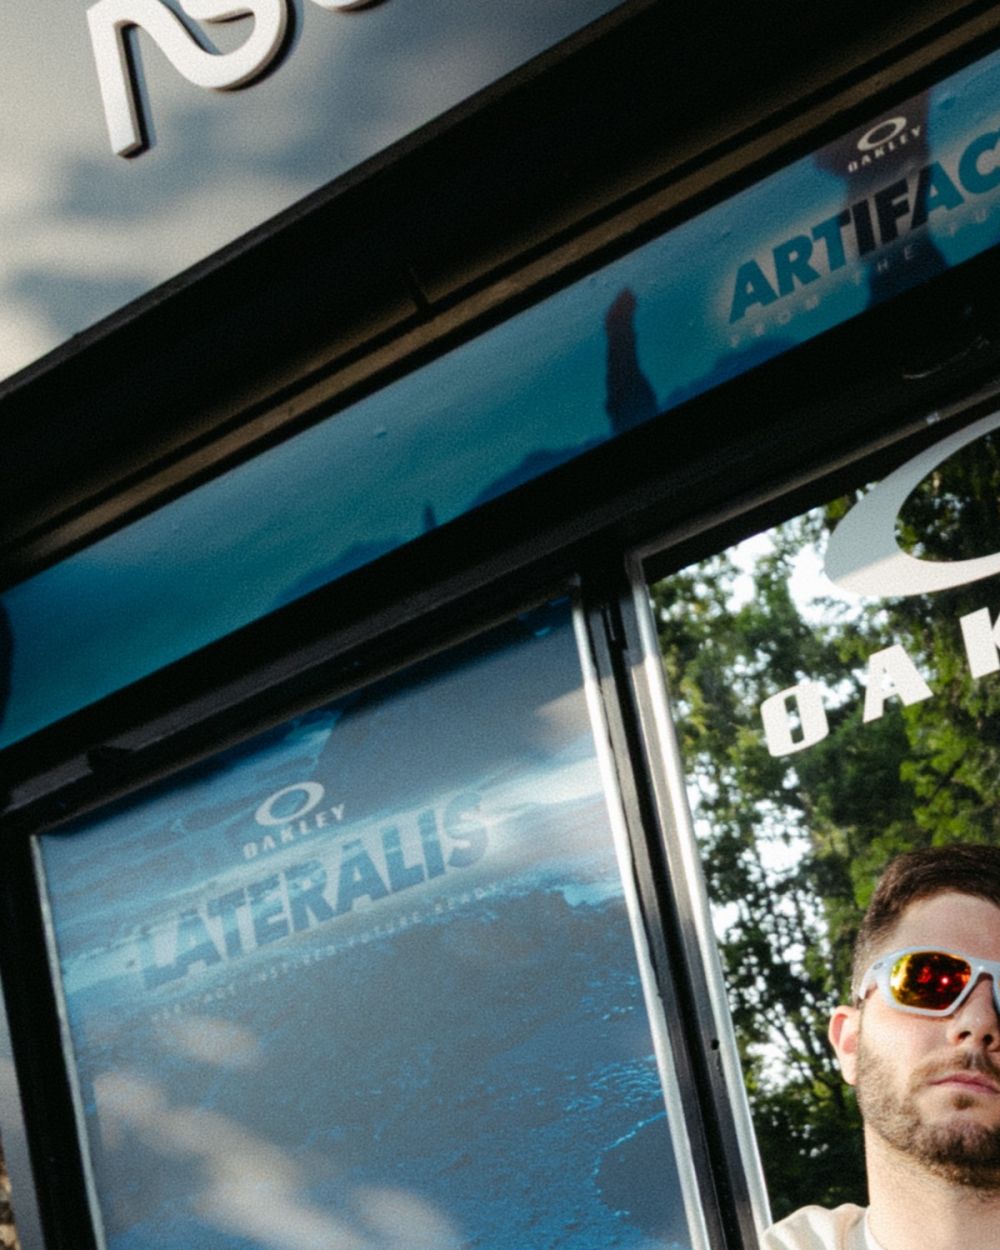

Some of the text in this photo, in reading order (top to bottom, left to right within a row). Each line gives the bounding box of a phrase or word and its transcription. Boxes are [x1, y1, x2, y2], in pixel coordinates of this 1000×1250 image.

[86, 0, 376, 158] NS
[847, 125, 921, 173] OAKLEY
[851, 246, 915, 288] THE
[243, 802, 345, 859] OAKLEY
[143, 792, 490, 988] LATERALIS
